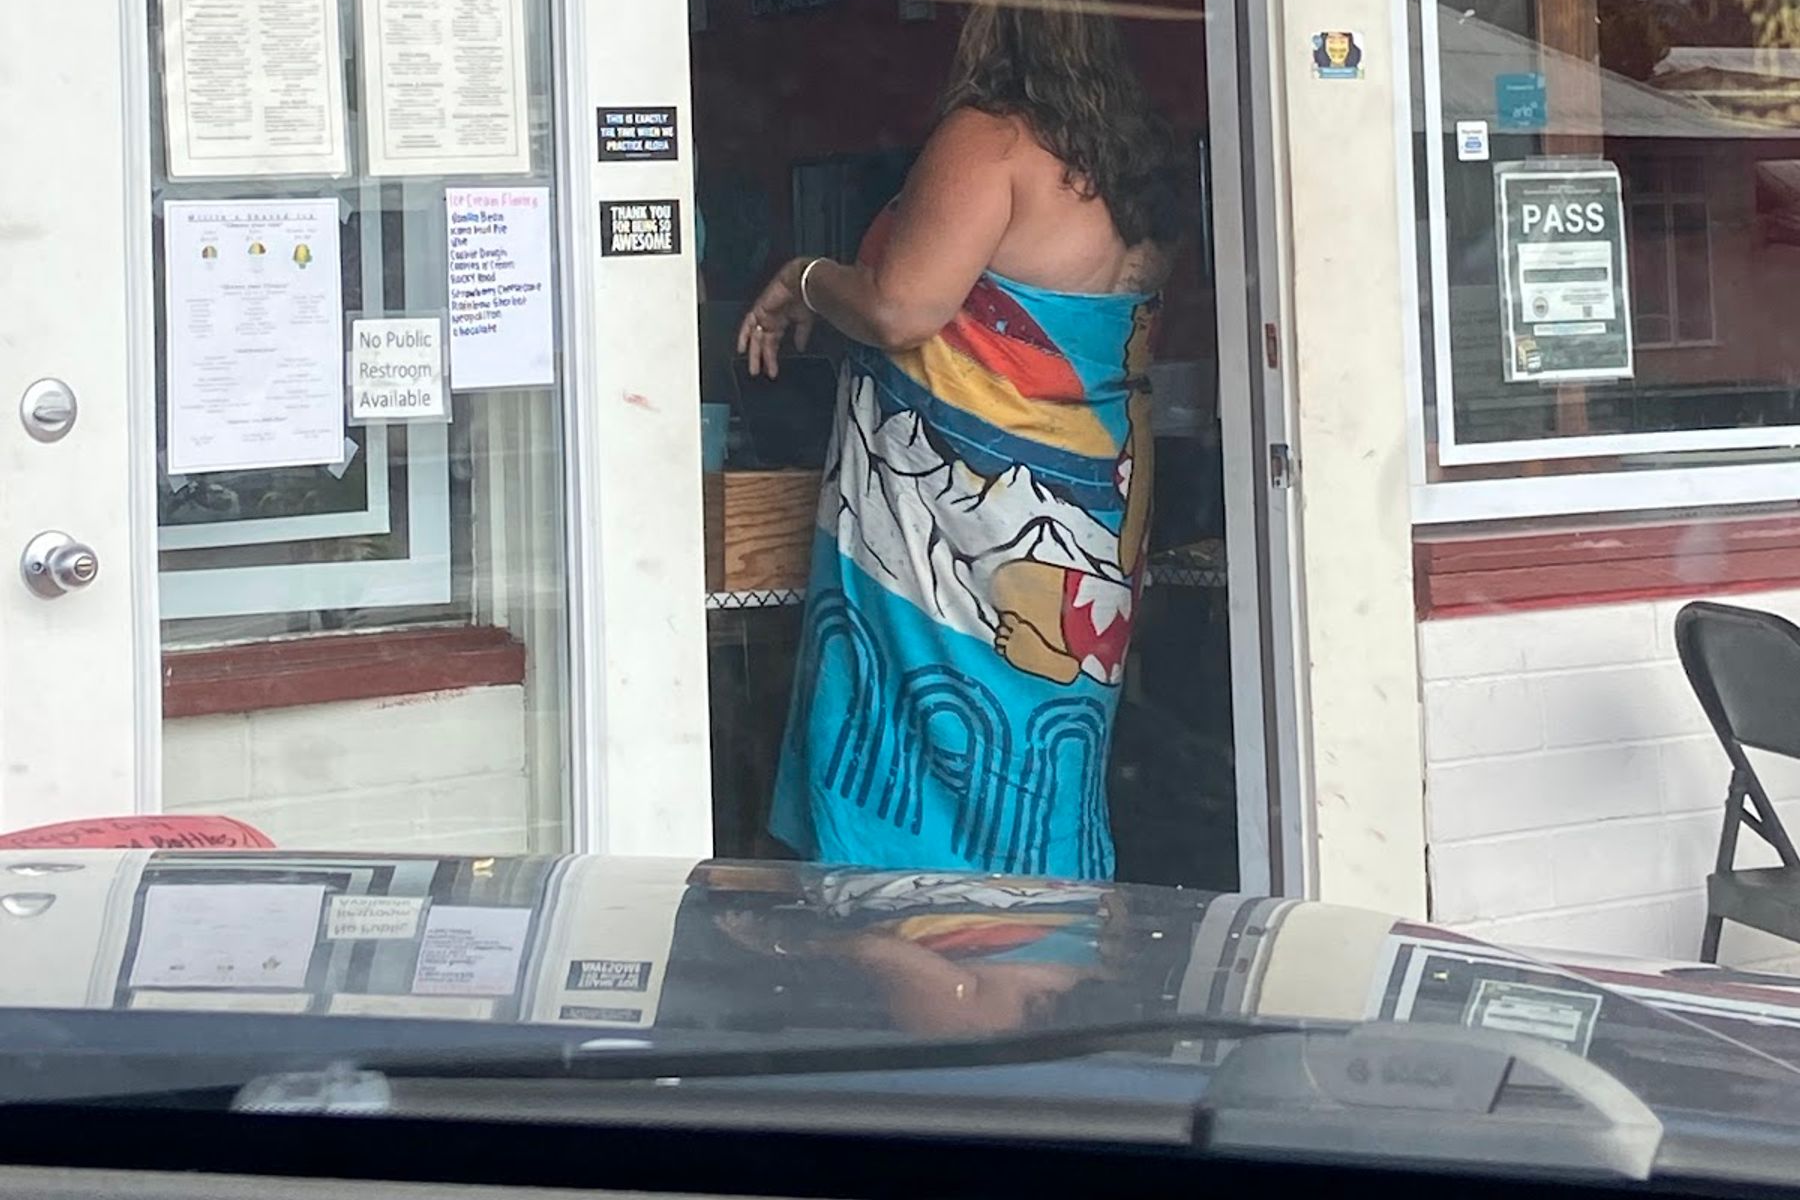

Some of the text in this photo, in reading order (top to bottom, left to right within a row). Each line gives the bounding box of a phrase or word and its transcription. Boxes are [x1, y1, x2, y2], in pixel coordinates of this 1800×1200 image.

[610, 205, 671, 220] THANK YOU
[1522, 202, 1605, 234] PASS
[612, 220, 630, 233] FOR
[658, 219, 672, 232] SO
[612, 232, 673, 252] AWESOME
[360, 329, 432, 348] No Public
[360, 362, 433, 378] Restroom
[360, 388, 432, 408] Available
